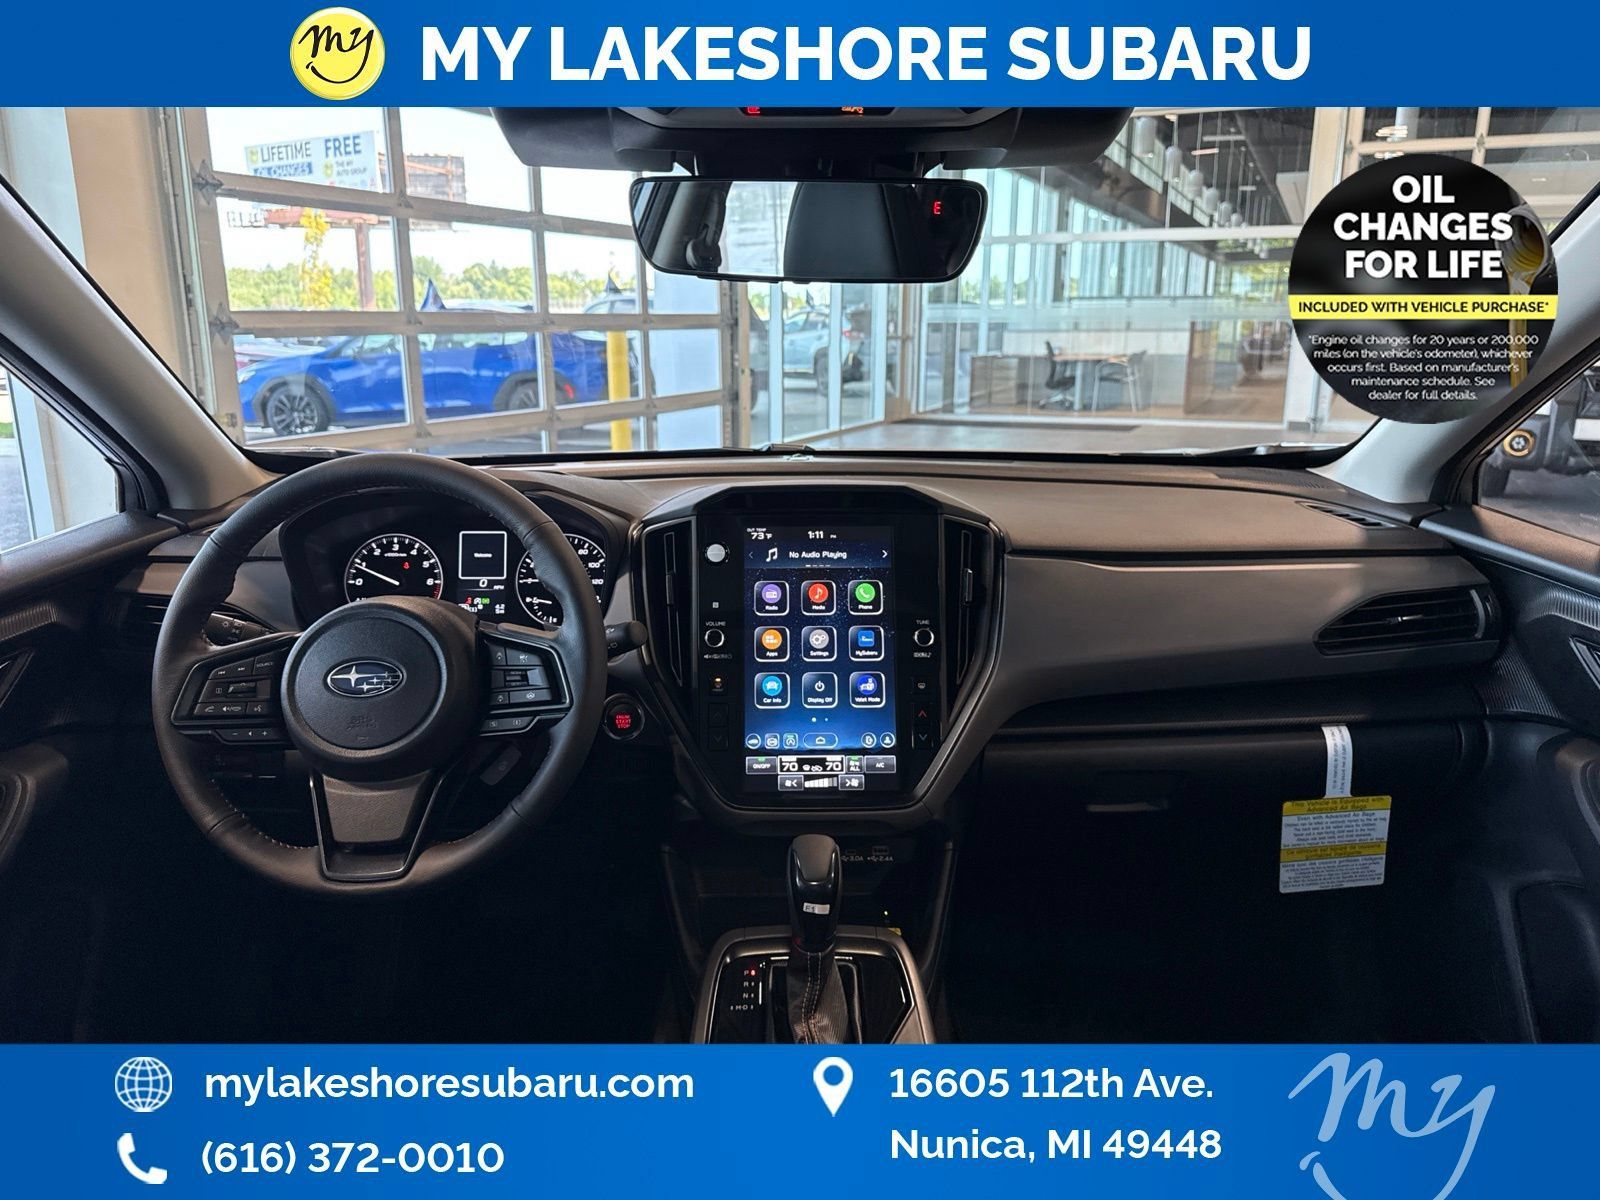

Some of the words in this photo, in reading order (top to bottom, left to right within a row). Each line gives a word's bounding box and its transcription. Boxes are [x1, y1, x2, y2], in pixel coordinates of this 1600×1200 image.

[324, 135, 362, 158] FREE
[260, 142, 311, 162] LIFETIME
[808, 531, 824, 539] 1:11
[789, 551, 799, 559] No
[822, 551, 847, 560] Playing
[355, 578, 363, 586] 0
[426, 578, 434, 586] 6
[479, 579, 488, 588] 0
[782, 762, 798, 771] 70
[825, 762, 842, 771] 70
